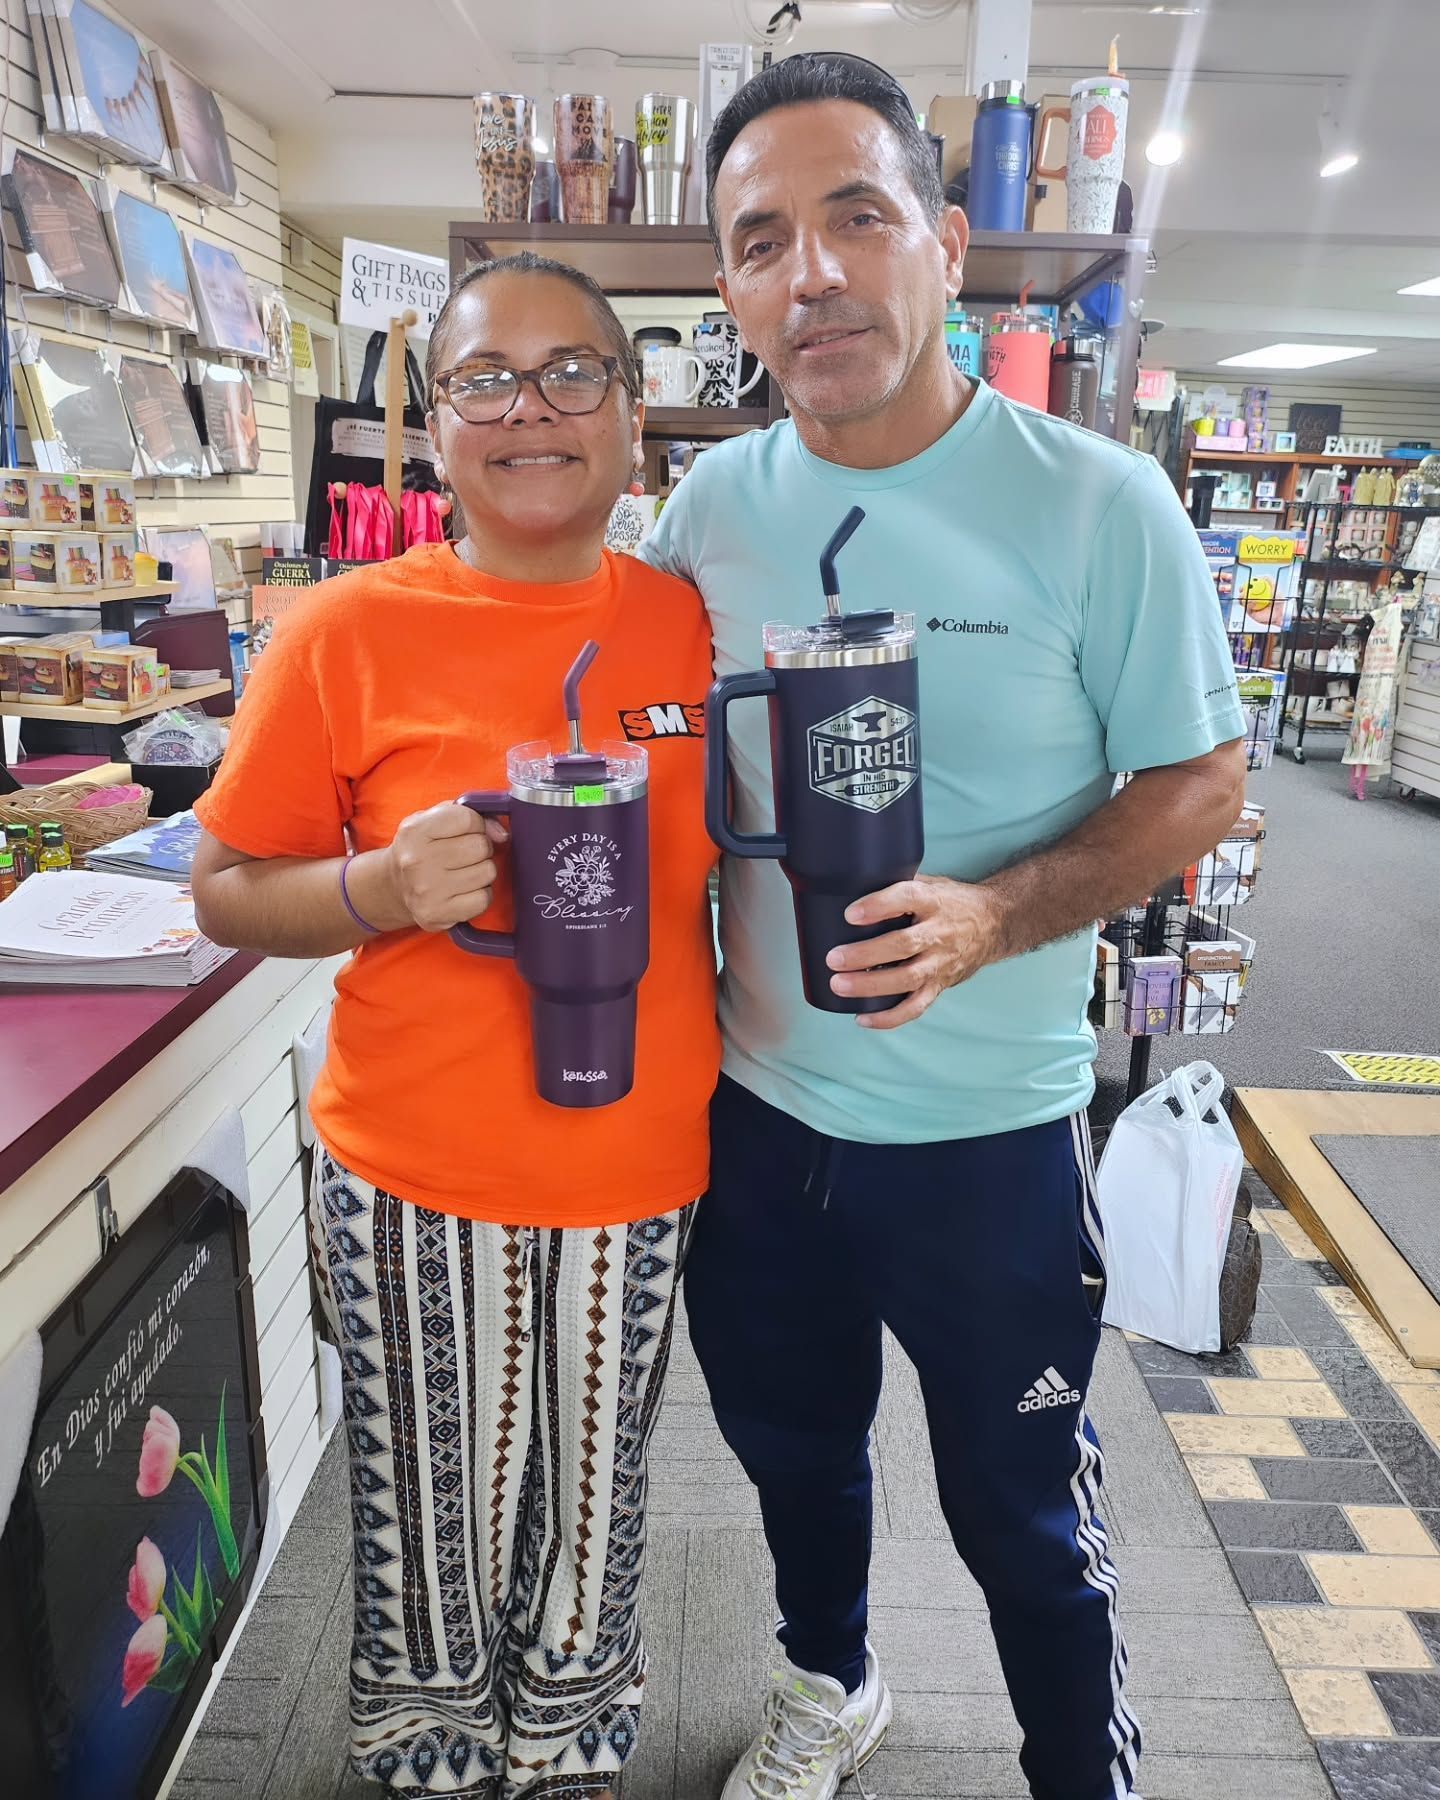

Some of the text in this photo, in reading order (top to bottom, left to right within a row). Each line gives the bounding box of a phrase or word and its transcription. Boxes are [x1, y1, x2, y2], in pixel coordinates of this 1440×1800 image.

[475, 127, 521, 160] Jesus
[572, 126, 607, 138] MOVE
[352, 254, 447, 292] GIFT BAGS
[351, 277, 372, 307] &
[1071, 370, 1081, 409] COURAGE
[1325, 435, 1384, 456] FAITH
[1246, 544, 1288, 555] WORRY
[272, 568, 311, 579] GUERRA
[942, 618, 1009, 635] Columbia
[829, 721, 854, 733] ISAIAH
[817, 732, 916, 778] FORGED
[852, 781, 895, 795] STRENGTH
[863, 771, 886, 782] IN HIS
[547, 833, 622, 862] EVERY DAY IS A
[533, 894, 634, 922] Blessing
[37, 1244, 211, 1488] En Dios confió mi corazón,
[95, 1318, 183, 1468] y fui ayudado.
[1017, 1389, 1081, 1413] adidas
